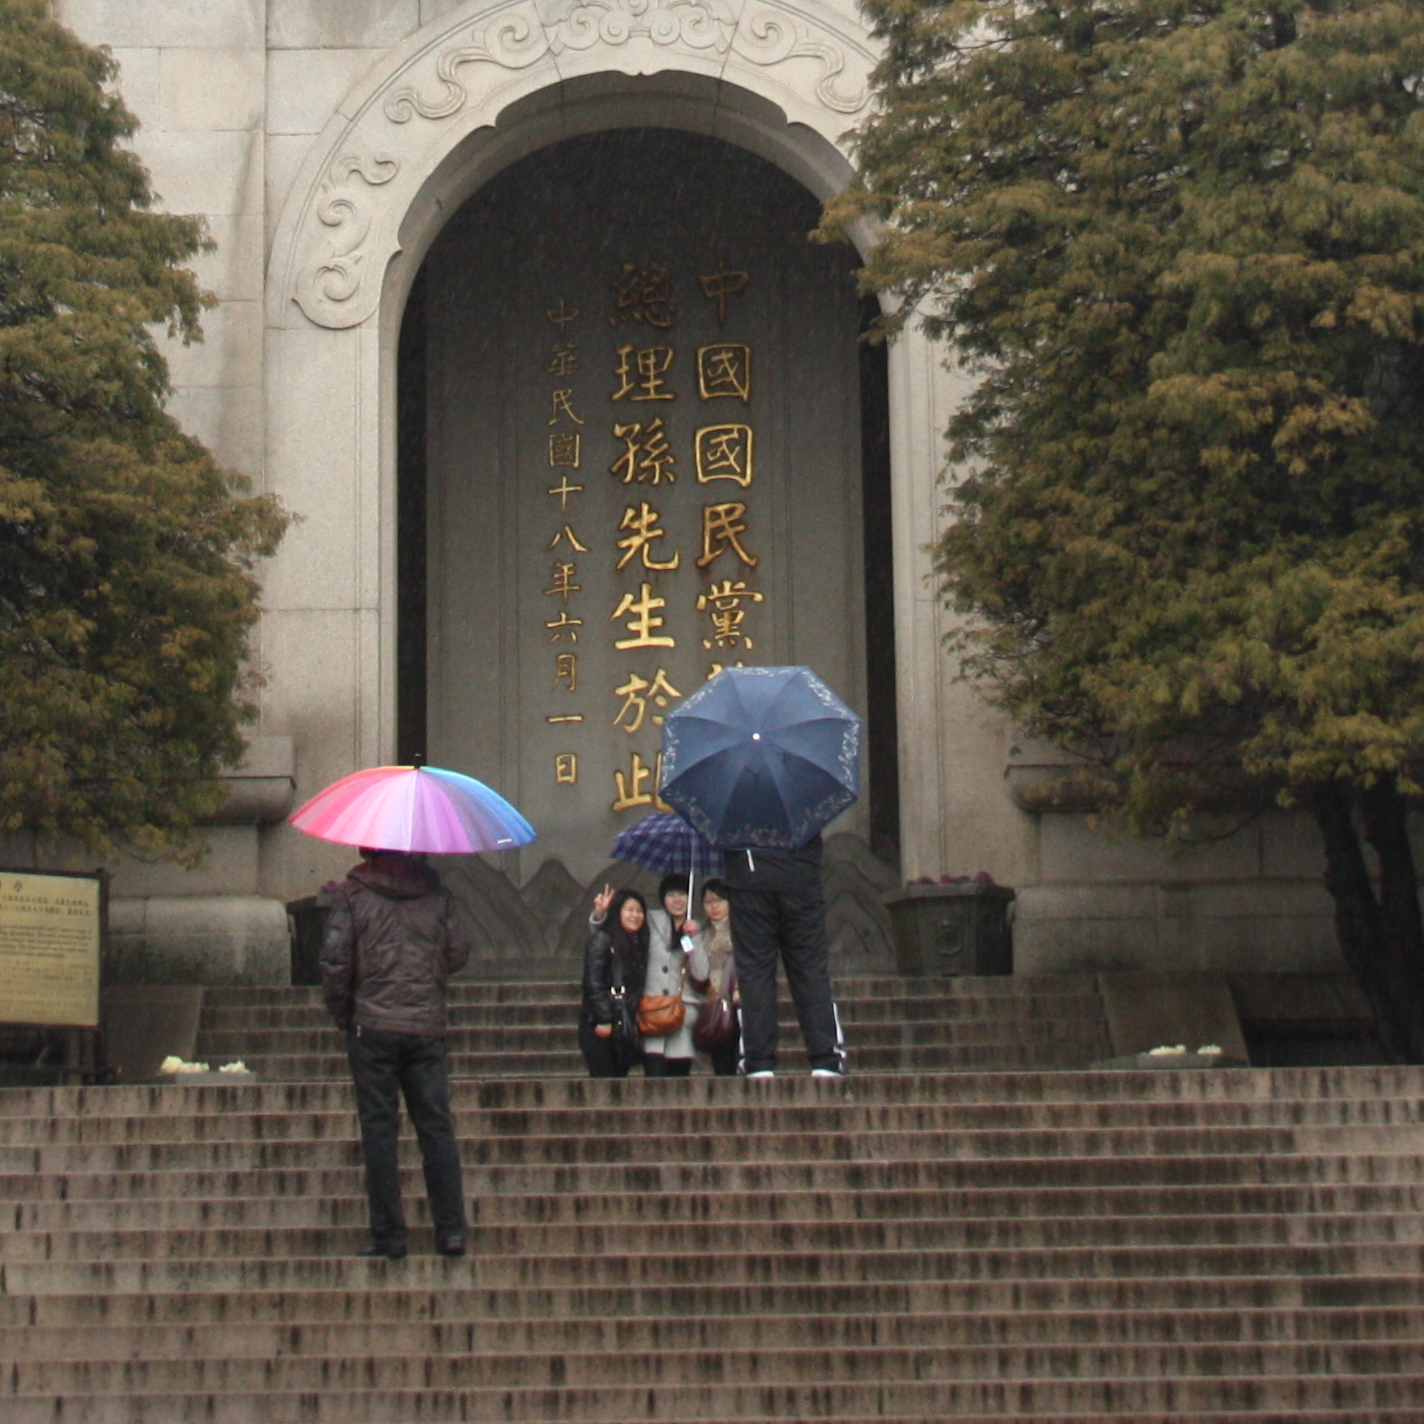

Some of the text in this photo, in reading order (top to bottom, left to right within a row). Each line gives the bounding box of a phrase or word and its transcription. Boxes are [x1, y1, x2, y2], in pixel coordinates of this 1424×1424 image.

[543, 298, 588, 785] 中華民國十八年六月一日
[695, 260, 763, 680] 中國國民黨
